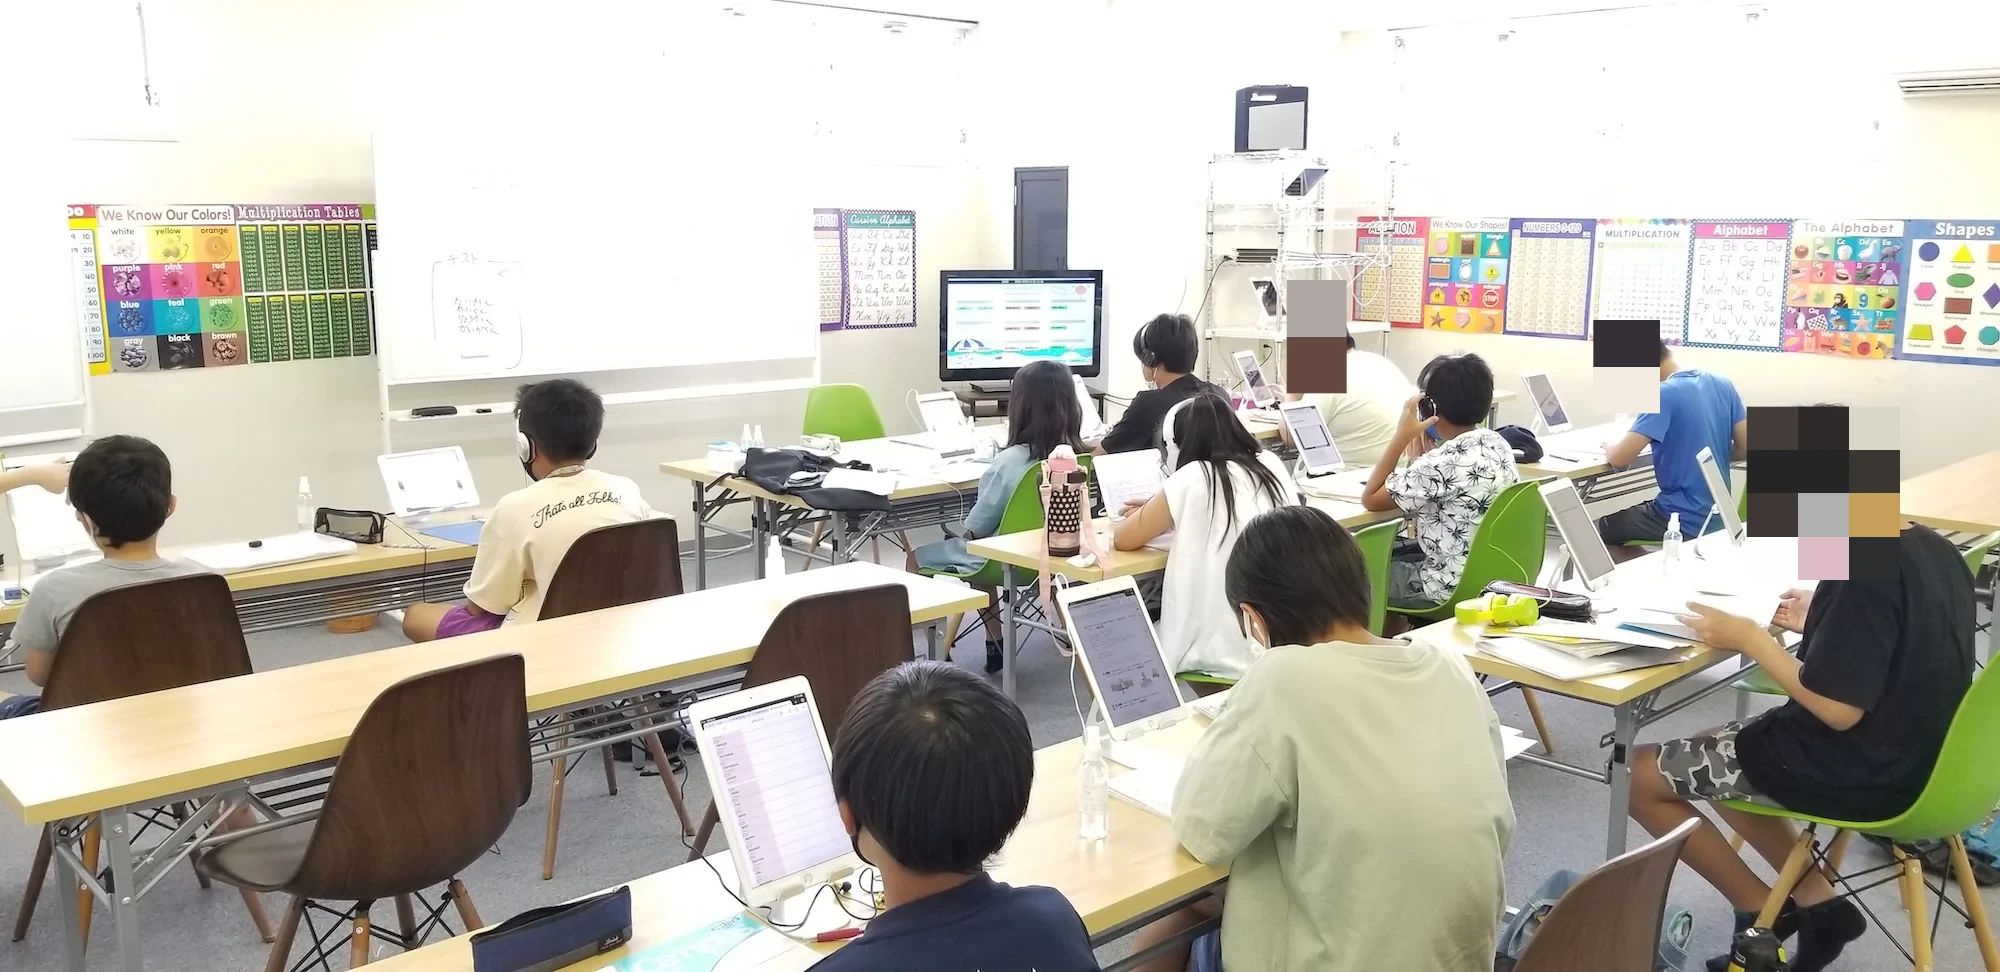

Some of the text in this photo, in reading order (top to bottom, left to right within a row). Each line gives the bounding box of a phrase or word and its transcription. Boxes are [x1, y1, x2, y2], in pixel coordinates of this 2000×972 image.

[102, 209, 232, 221] We Know Our Colors!
[238, 206, 360, 220] Multiplication Tables
[1445, 221, 1463, 229] Know
[1466, 221, 1477, 229] Our
[1480, 221, 1508, 230] Shapes!
[1524, 224, 1560, 233] NUMBERS
[1804, 224, 1894, 234] The Alphabet
[155, 228, 181, 236] yellow
[1606, 230, 1680, 238] MULTIPLICATION
[1713, 224, 1768, 237] Alphabet
[1936, 222, 1995, 239] Shapes
[113, 265, 141, 273] purple
[164, 264, 183, 272] pink
[212, 262, 225, 270] red
[120, 301, 140, 309] blue
[168, 299, 185, 307] teal
[210, 298, 233, 306] green
[168, 334, 191, 342] black
[212, 332, 237, 340] brown
[124, 338, 143, 346] gray
[569, 496, 587, 508] all
